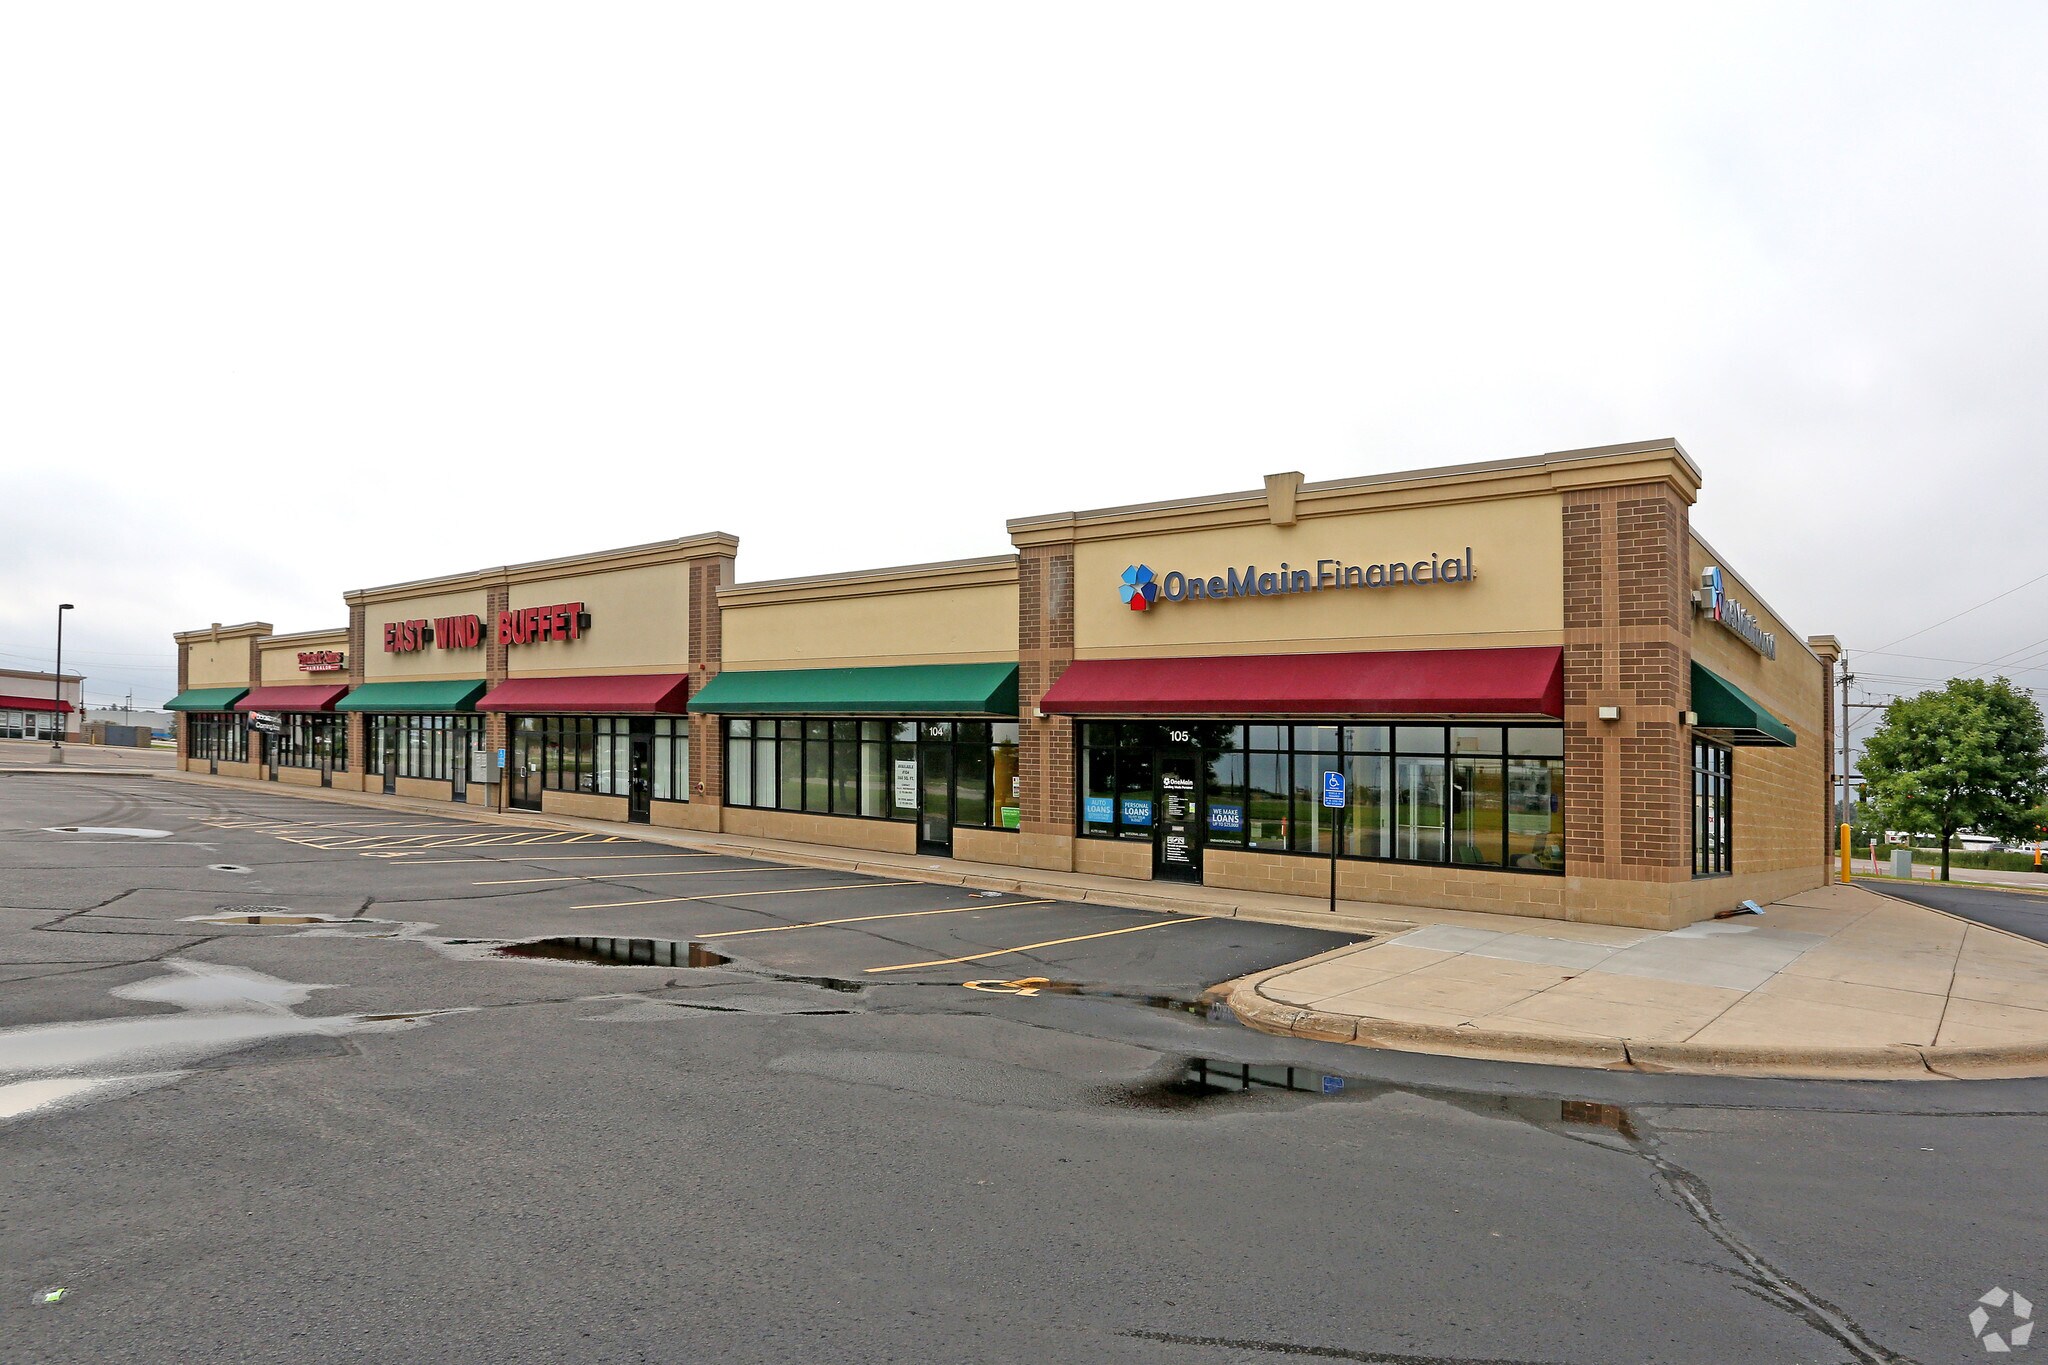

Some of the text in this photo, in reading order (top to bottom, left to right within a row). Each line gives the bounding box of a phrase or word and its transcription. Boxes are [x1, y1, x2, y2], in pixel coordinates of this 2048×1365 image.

[1163, 547, 1473, 601] OneMainFinancial
[384, 602, 584, 653] EAST WIND BUFFET
[929, 726, 944, 737] 104
[1169, 730, 1189, 742] 105
[1087, 805, 1110, 814] LOANS
[1124, 807, 1149, 817] LOANS
[1212, 814, 1240, 824] LOANS
